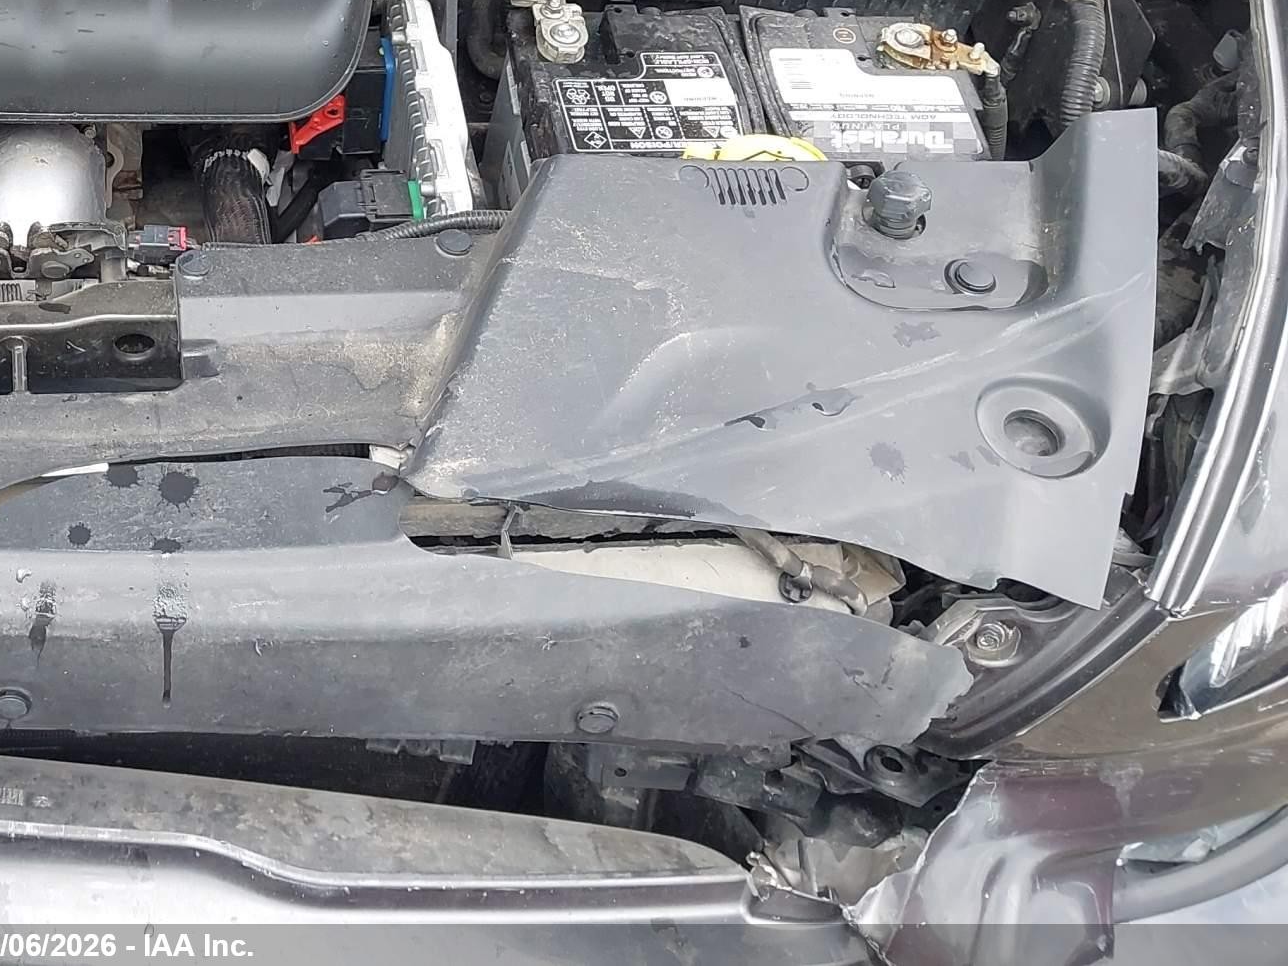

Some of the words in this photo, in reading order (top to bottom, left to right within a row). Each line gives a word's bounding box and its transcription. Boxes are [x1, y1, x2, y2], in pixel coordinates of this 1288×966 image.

[831, 112, 906, 121] TECHNOLOGY
[830, 122, 900, 132] PLATINUM
[830, 130, 954, 151] Duralast
